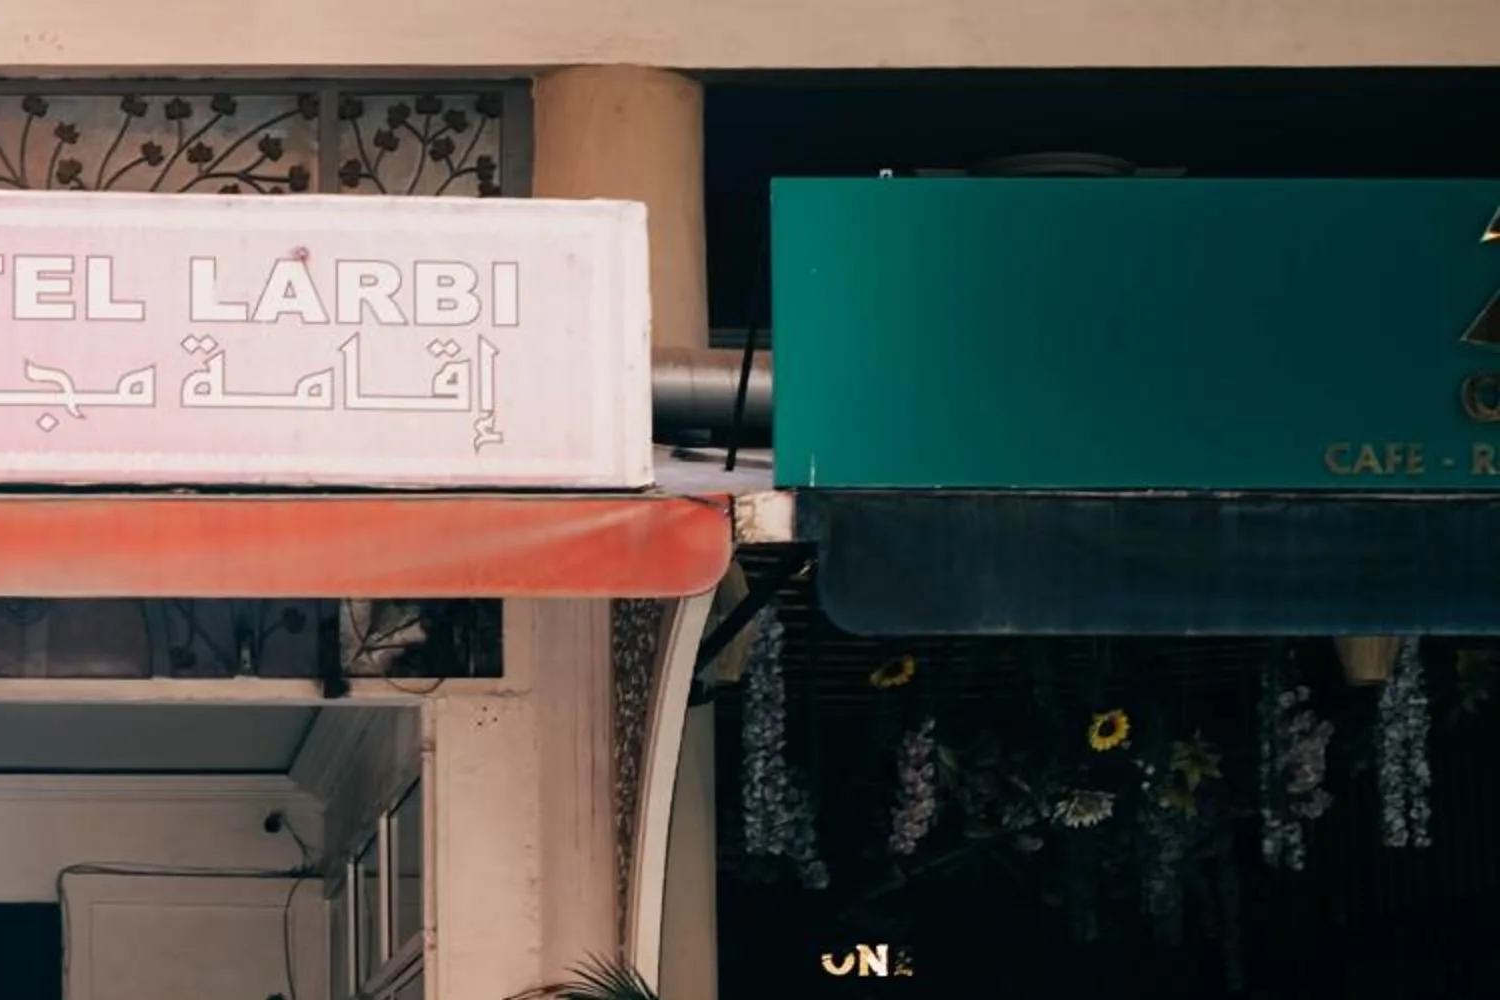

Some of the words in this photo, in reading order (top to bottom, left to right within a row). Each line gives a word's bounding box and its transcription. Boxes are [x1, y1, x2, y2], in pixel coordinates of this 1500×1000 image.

[189, 255, 520, 326] LARBI
[180, 332, 504, 454] إقامة
[1323, 443, 1426, 475] CAFE
[1471, 443, 1500, 475] R
